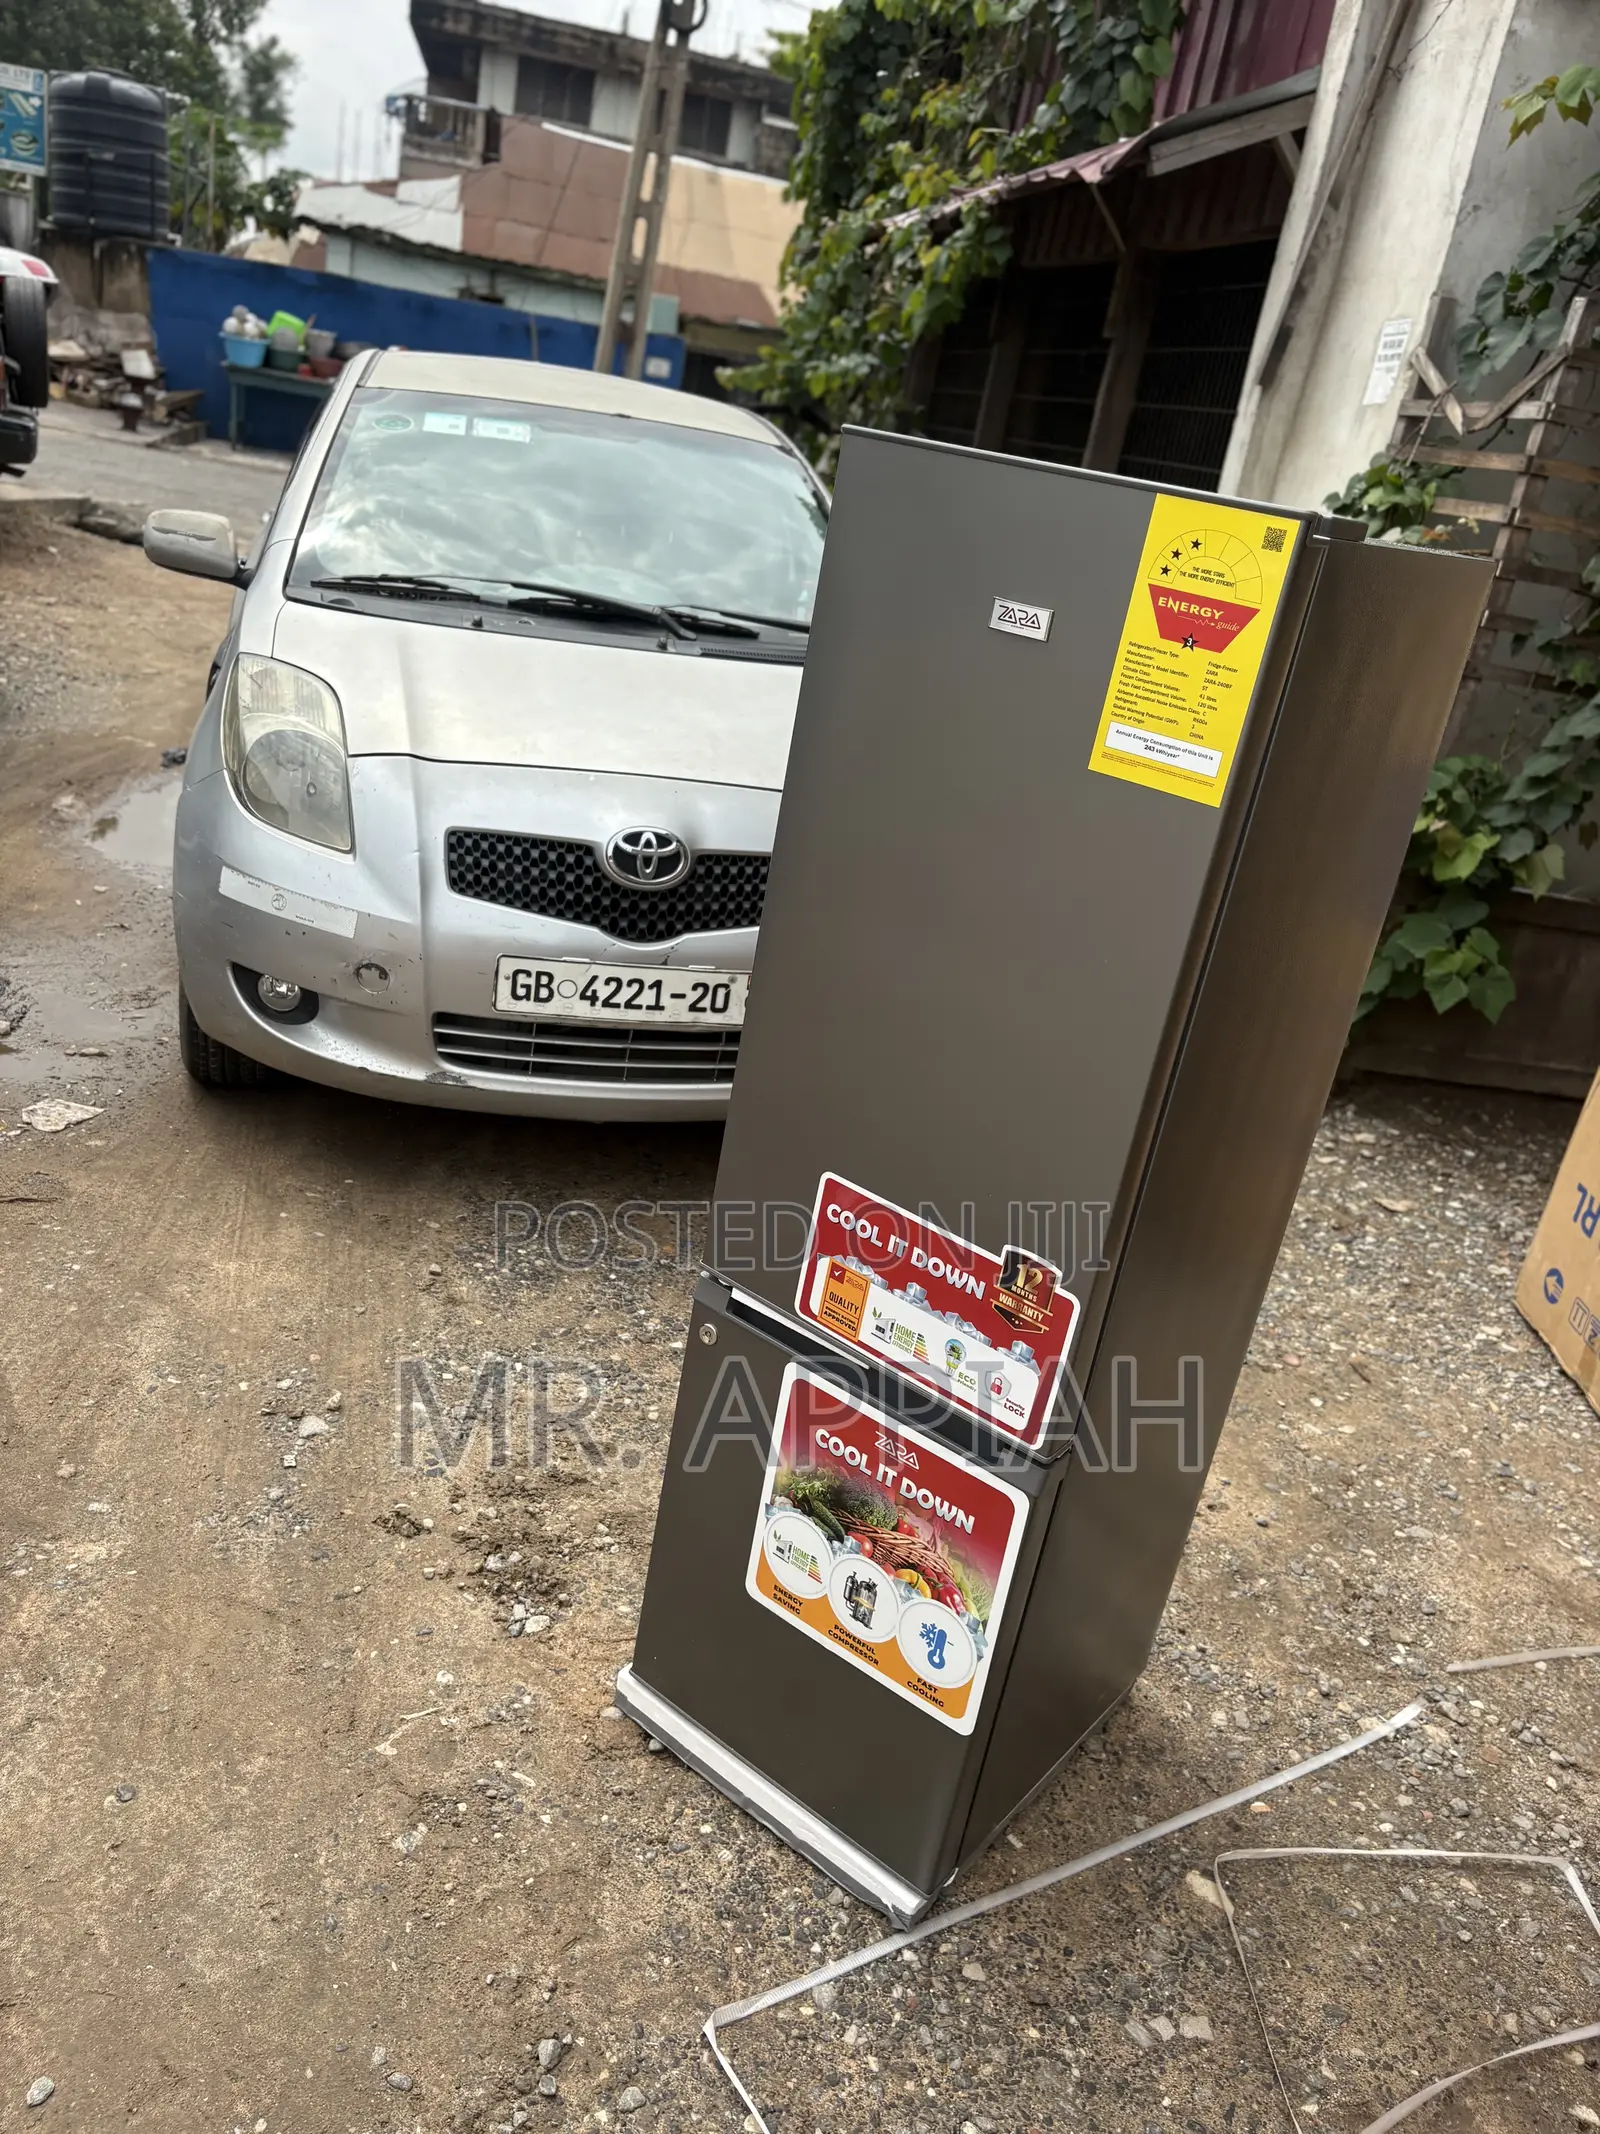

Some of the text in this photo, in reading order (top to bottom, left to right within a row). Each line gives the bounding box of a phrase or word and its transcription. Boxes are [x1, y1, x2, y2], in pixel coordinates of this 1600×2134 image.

[1187, 572, 1200, 580] MORE
[1200, 575, 1216, 583] ENERGY
[1215, 578, 1236, 588] EFFICIENT
[1200, 568, 1213, 576] MORE
[1213, 571, 1226, 579] STARS
[1158, 596, 1224, 620] ENERGY
[997, 604, 1041, 630] ZARA
[1215, 621, 1240, 632] guide
[1186, 637, 1193, 647] 3
[1122, 664, 1138, 674] Climate
[1155, 665, 1169, 673] Model
[1205, 669, 1219, 677] ZARA
[1207, 660, 1239, 674] Fridge-Freezer
[1120, 672, 1134, 680] Frozen
[1134, 675, 1163, 688] Compartment
[1130, 683, 1141, 691] Food
[1141, 686, 1170, 698] Compartment
[1206, 695, 1217, 703] litres
[1116, 688, 1134, 698] Airborne
[1155, 699, 1168, 707] Noise
[1168, 702, 1187, 712] Emission
[1196, 701, 1218, 712] 120 litres
[1110, 711, 1127, 720] Country
[1112, 703, 1126, 711] Global
[1126, 706, 1145, 717] Warming
[1145, 711, 1165, 722] Potential
[1115, 729, 1132, 739] Annual
[1132, 733, 1149, 744] Energy
[1149, 738, 1181, 751] Consumption
[1187, 748, 1197, 756] this
[1197, 751, 1208, 760] Unit
[1188, 731, 1204, 741] CHINA
[1143, 744, 1156, 753] 243
[510, 968, 731, 1014] GB 4221-20
[826, 1203, 987, 1300] COOL IT DOWN
[1016, 1264, 1043, 1295] 12
[1011, 1284, 1038, 1302] MONTHS
[828, 1291, 860, 1315] QUALITY
[998, 1292, 1044, 1322] WARRANTY
[823, 1310, 857, 1332] APPROVED
[893, 1332, 915, 1348] ENERGY
[895, 1322, 917, 1342] HOME
[891, 1340, 912, 1355] EFFICIENCY
[958, 1371, 977, 1385] ECO
[1003, 1402, 1026, 1419] LOCK
[1005, 1397, 1026, 1412] Security
[874, 1430, 920, 1471] ZARA
[815, 1428, 976, 1535] COOL IT DOWN
[791, 1553, 809, 1569] ENERGY
[792, 1545, 811, 1563] HOME
[790, 1560, 808, 1574] EFFICIENCY
[772, 1593, 801, 1615] SAVING
[773, 1584, 804, 1608] ENERGY
[828, 1629, 880, 1666] COMPRESSOR
[834, 1624, 876, 1656] POWERFUL
[906, 1680, 945, 1708] COOLING
[917, 1677, 939, 1694] FAST
